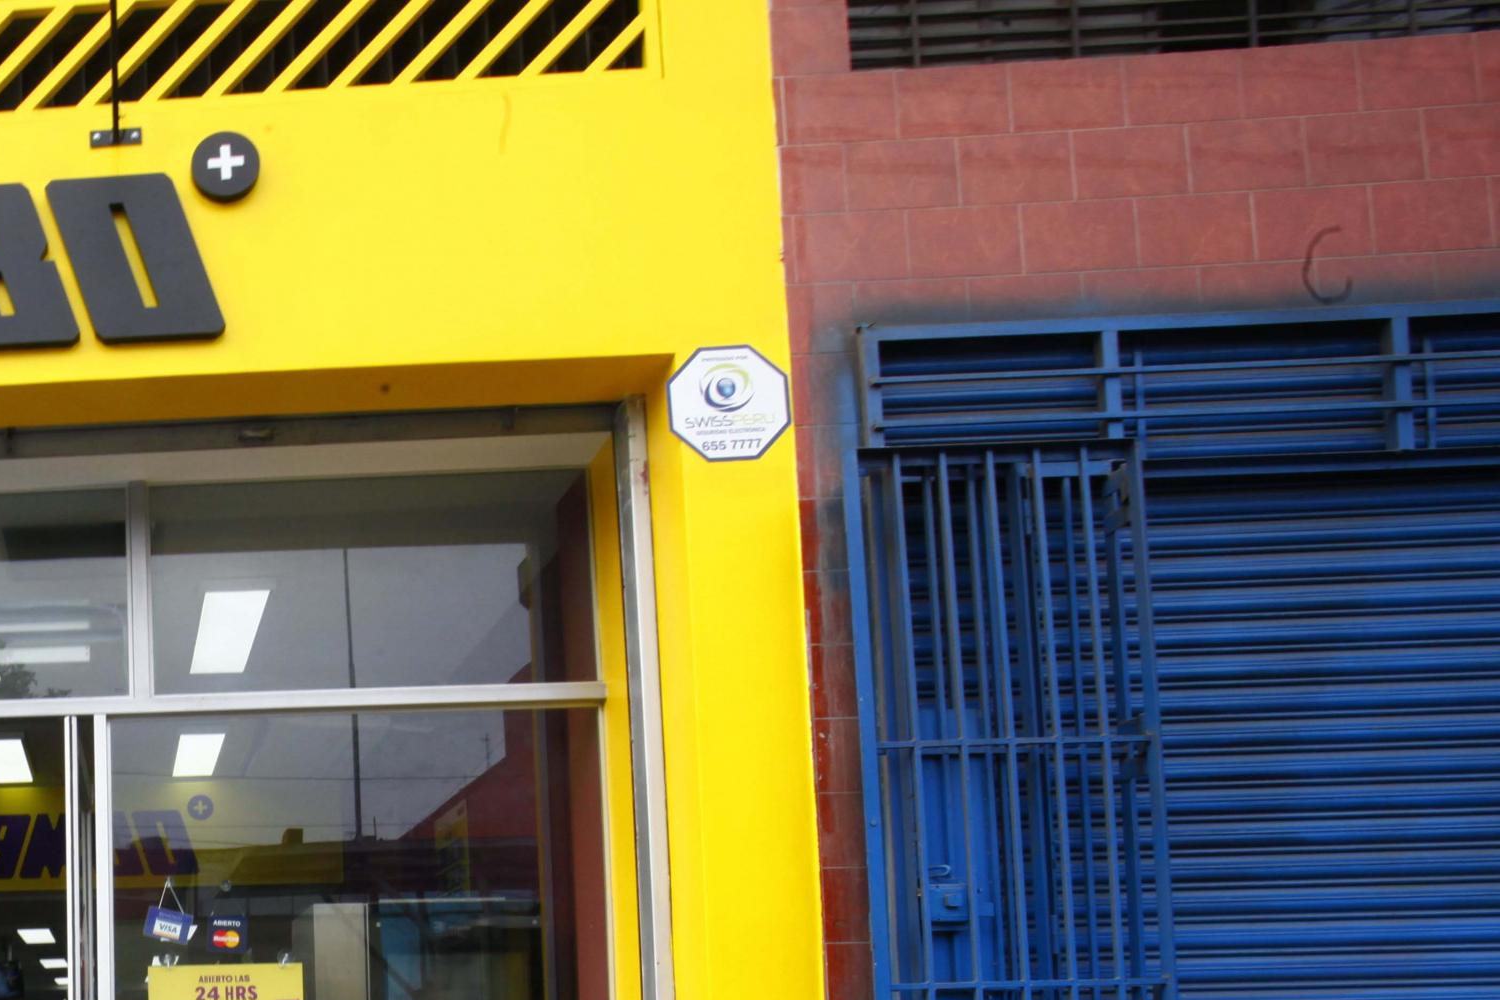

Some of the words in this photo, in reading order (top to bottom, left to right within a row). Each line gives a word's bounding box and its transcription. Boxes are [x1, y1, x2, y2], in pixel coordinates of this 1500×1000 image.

[702, 440, 727, 451] 655
[730, 438, 762, 450] 7777
[212, 919, 242, 928] ABIERTO
[198, 975, 233, 984] ABIERTO
